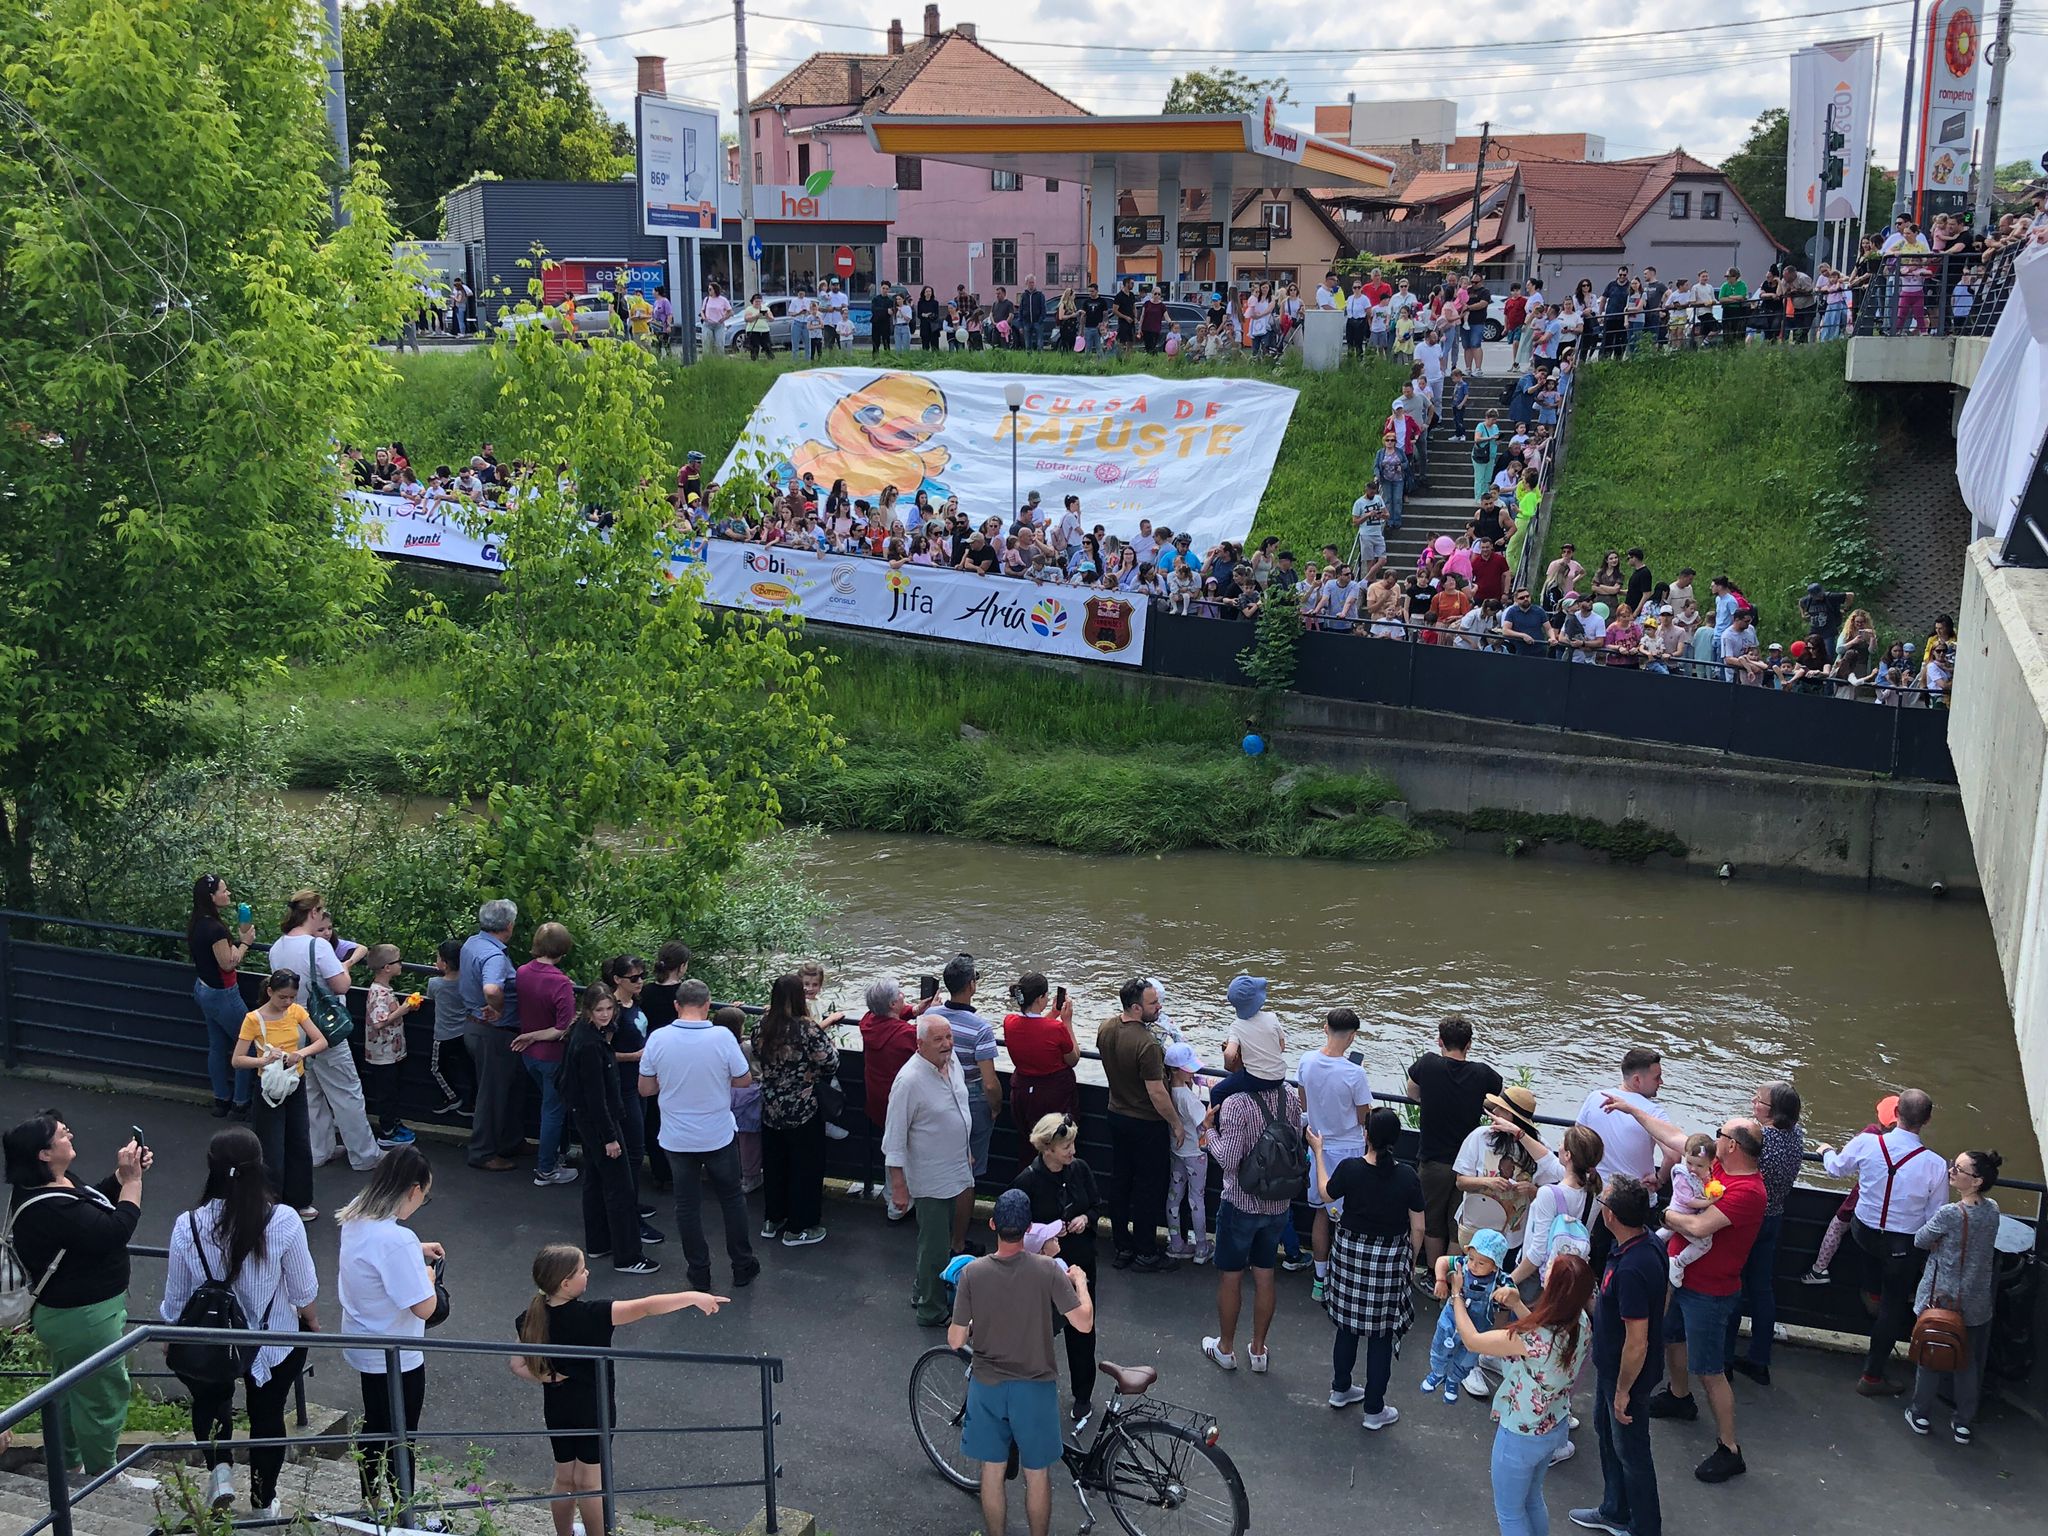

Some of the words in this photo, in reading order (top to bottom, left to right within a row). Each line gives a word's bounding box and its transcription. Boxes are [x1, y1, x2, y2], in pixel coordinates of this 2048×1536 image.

[1939, 88, 1975, 104] rompetrol
[650, 171, 666, 186] 869
[781, 190, 819, 217] hei
[1025, 394, 1148, 414] CURSA
[1174, 399, 1223, 420] DE
[1035, 459, 1092, 473] Rotaract
[1059, 472, 1087, 484] Sibiu
[405, 532, 441, 546] Avanti
[744, 551, 785, 574] Robi
[953, 591, 1029, 634] Aria
